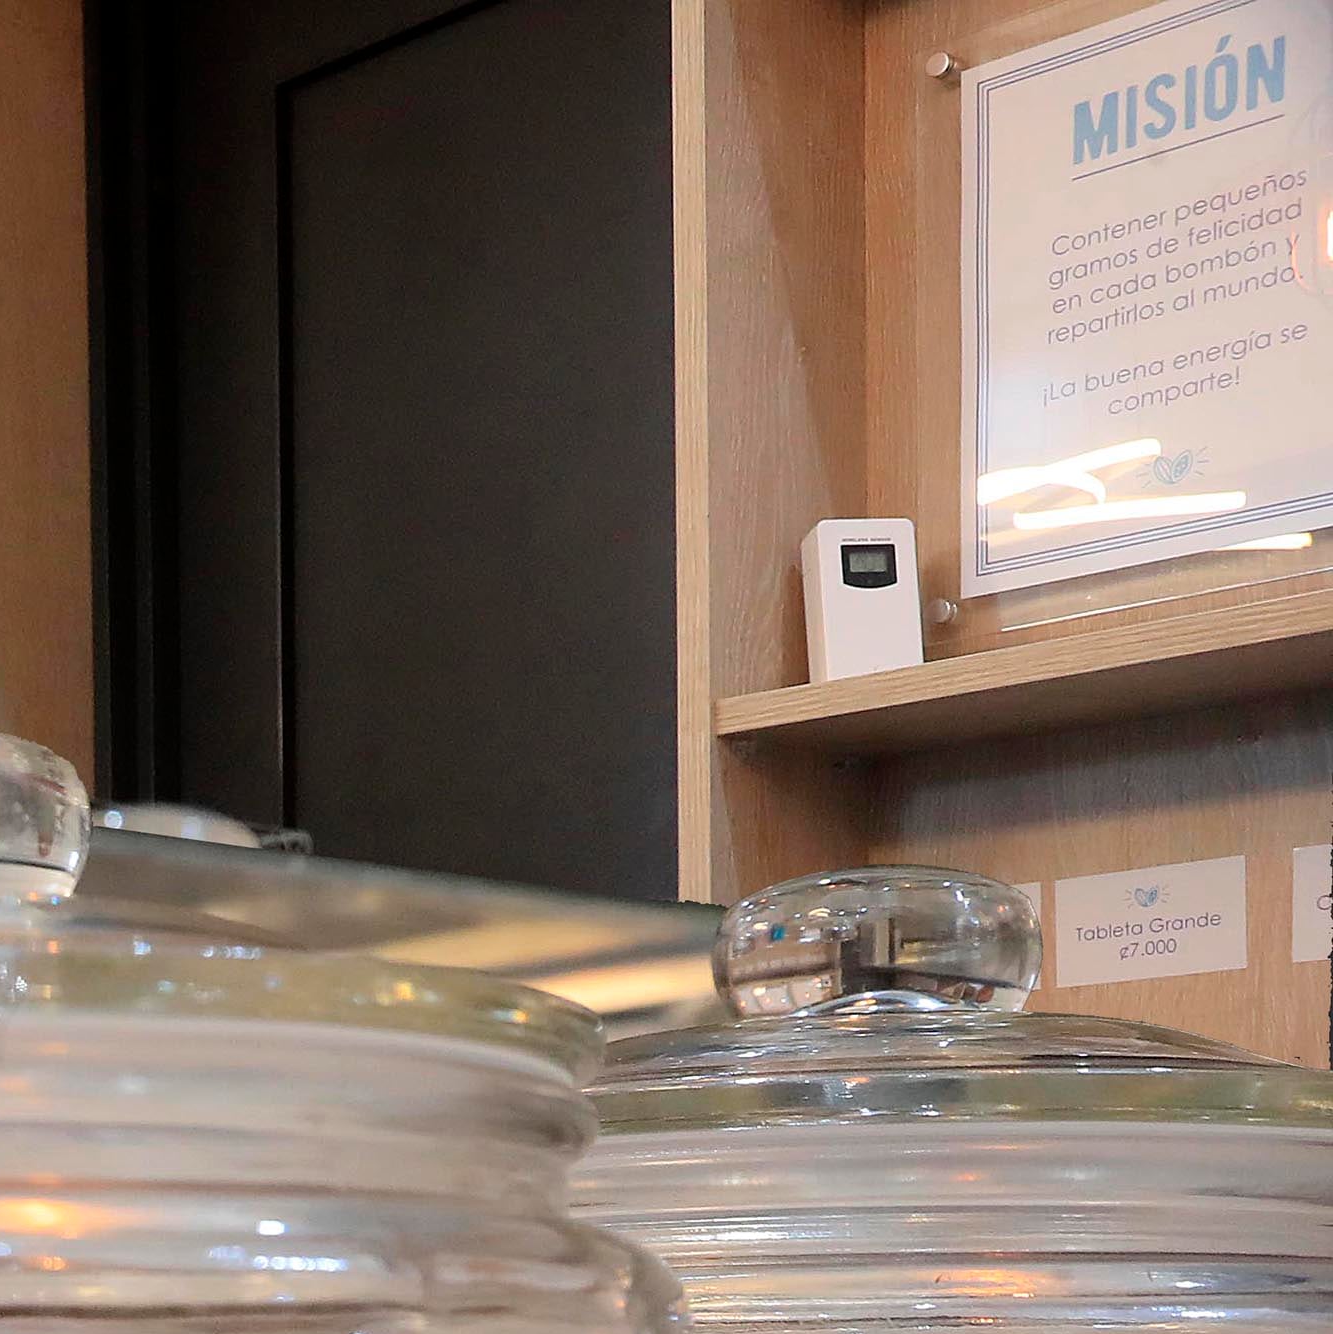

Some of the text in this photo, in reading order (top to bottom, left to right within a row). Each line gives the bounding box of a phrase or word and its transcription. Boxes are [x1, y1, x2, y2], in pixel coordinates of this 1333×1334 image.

[1072, 34, 1286, 165] MISIÓN
[1048, 197, 1303, 291] gramos de felicidad
[1051, 169, 1308, 256] Contener pequeños
[1046, 265, 1304, 345] repartirlos al mundo.
[1052, 232, 1300, 314] en cada bombón y
[1042, 323, 1308, 408] ¡La buena energía se
[1107, 365, 1241, 416] comparte!
[1075, 911, 1222, 942] Tableta Grande
